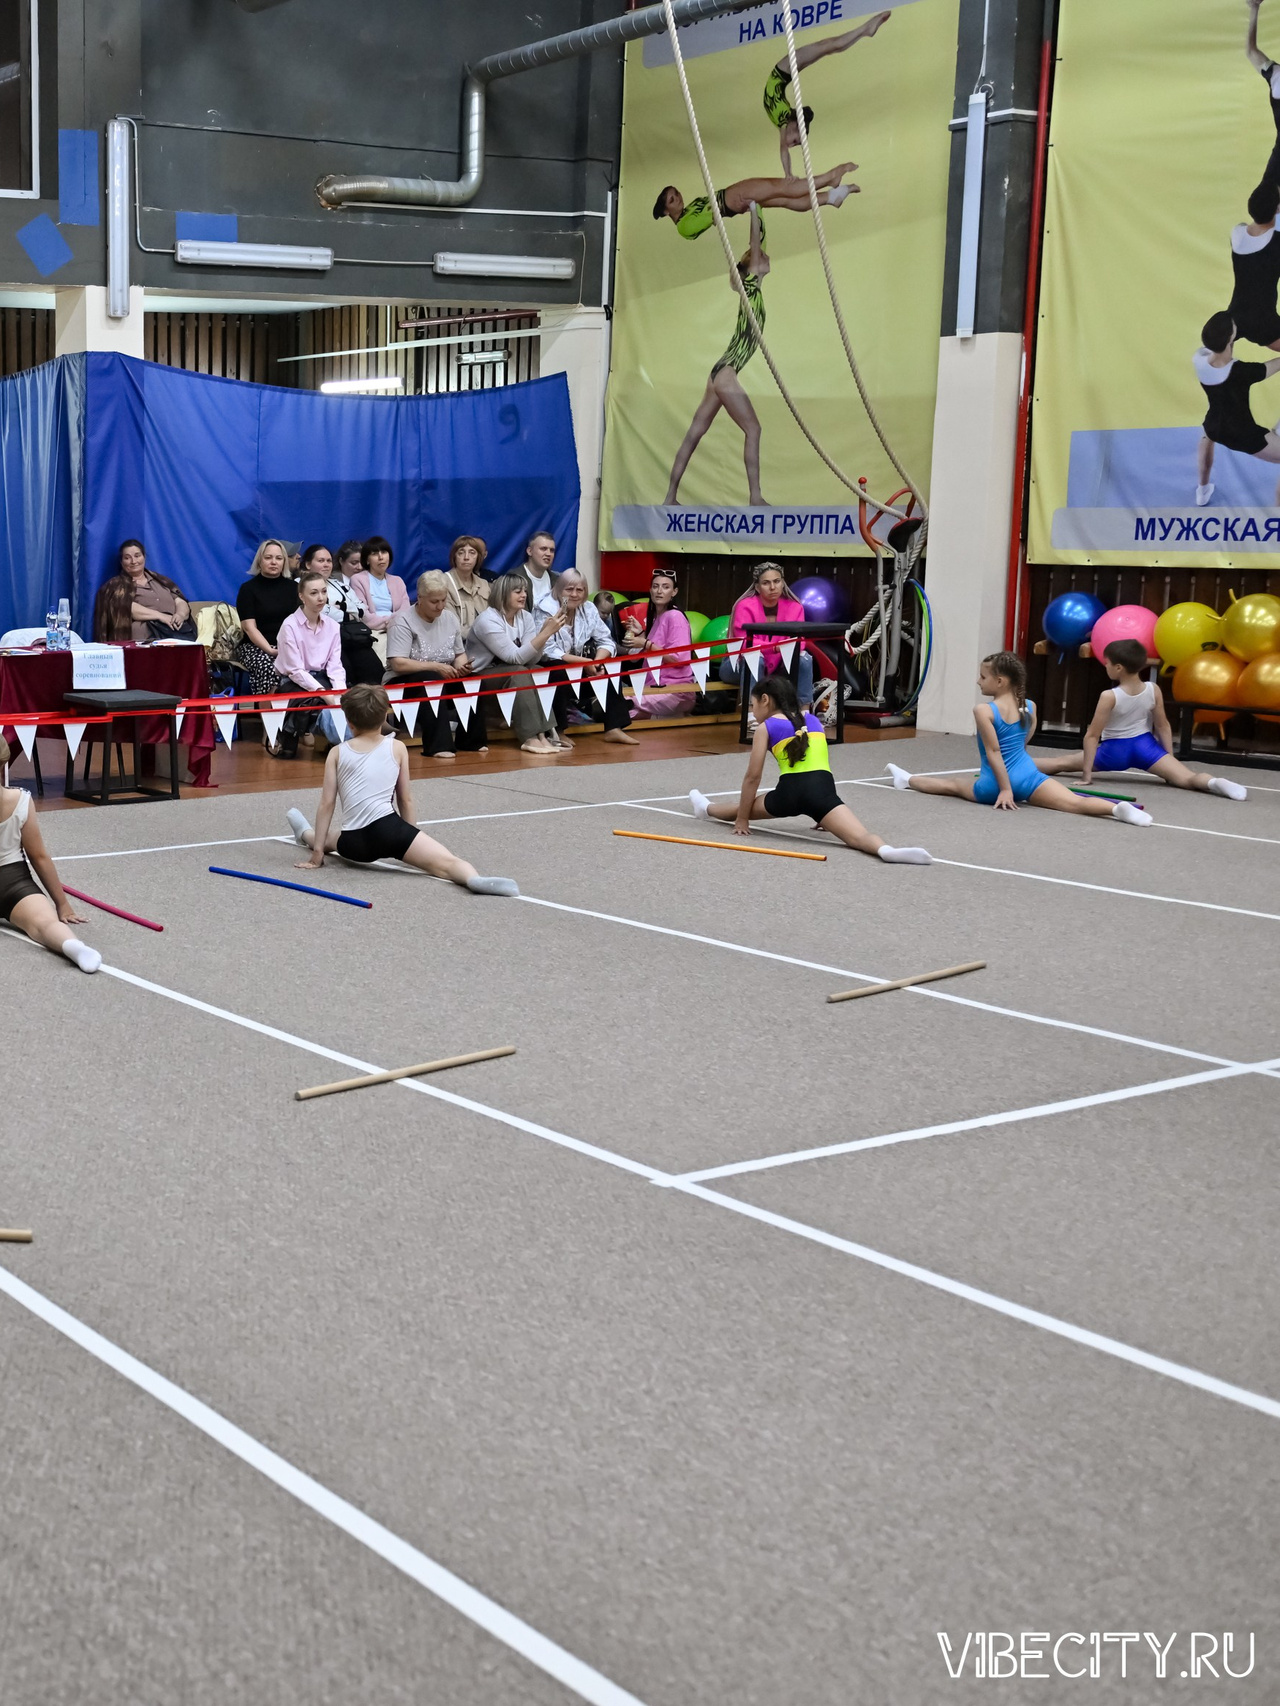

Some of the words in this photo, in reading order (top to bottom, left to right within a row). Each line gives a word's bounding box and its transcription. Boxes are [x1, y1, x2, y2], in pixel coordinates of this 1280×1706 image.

[738, 17, 766, 43] НА
[773, 0, 842, 34] КОВРЕ
[666, 513, 765, 534] ЖЕНСКАЯ
[771, 514, 855, 535] ГРУППА
[1134, 517, 1280, 542] МУЖСКАЯ
[83, 652, 114, 660] Главный
[89, 663, 108, 671] судья
[75, 671, 122, 679] соревнований
